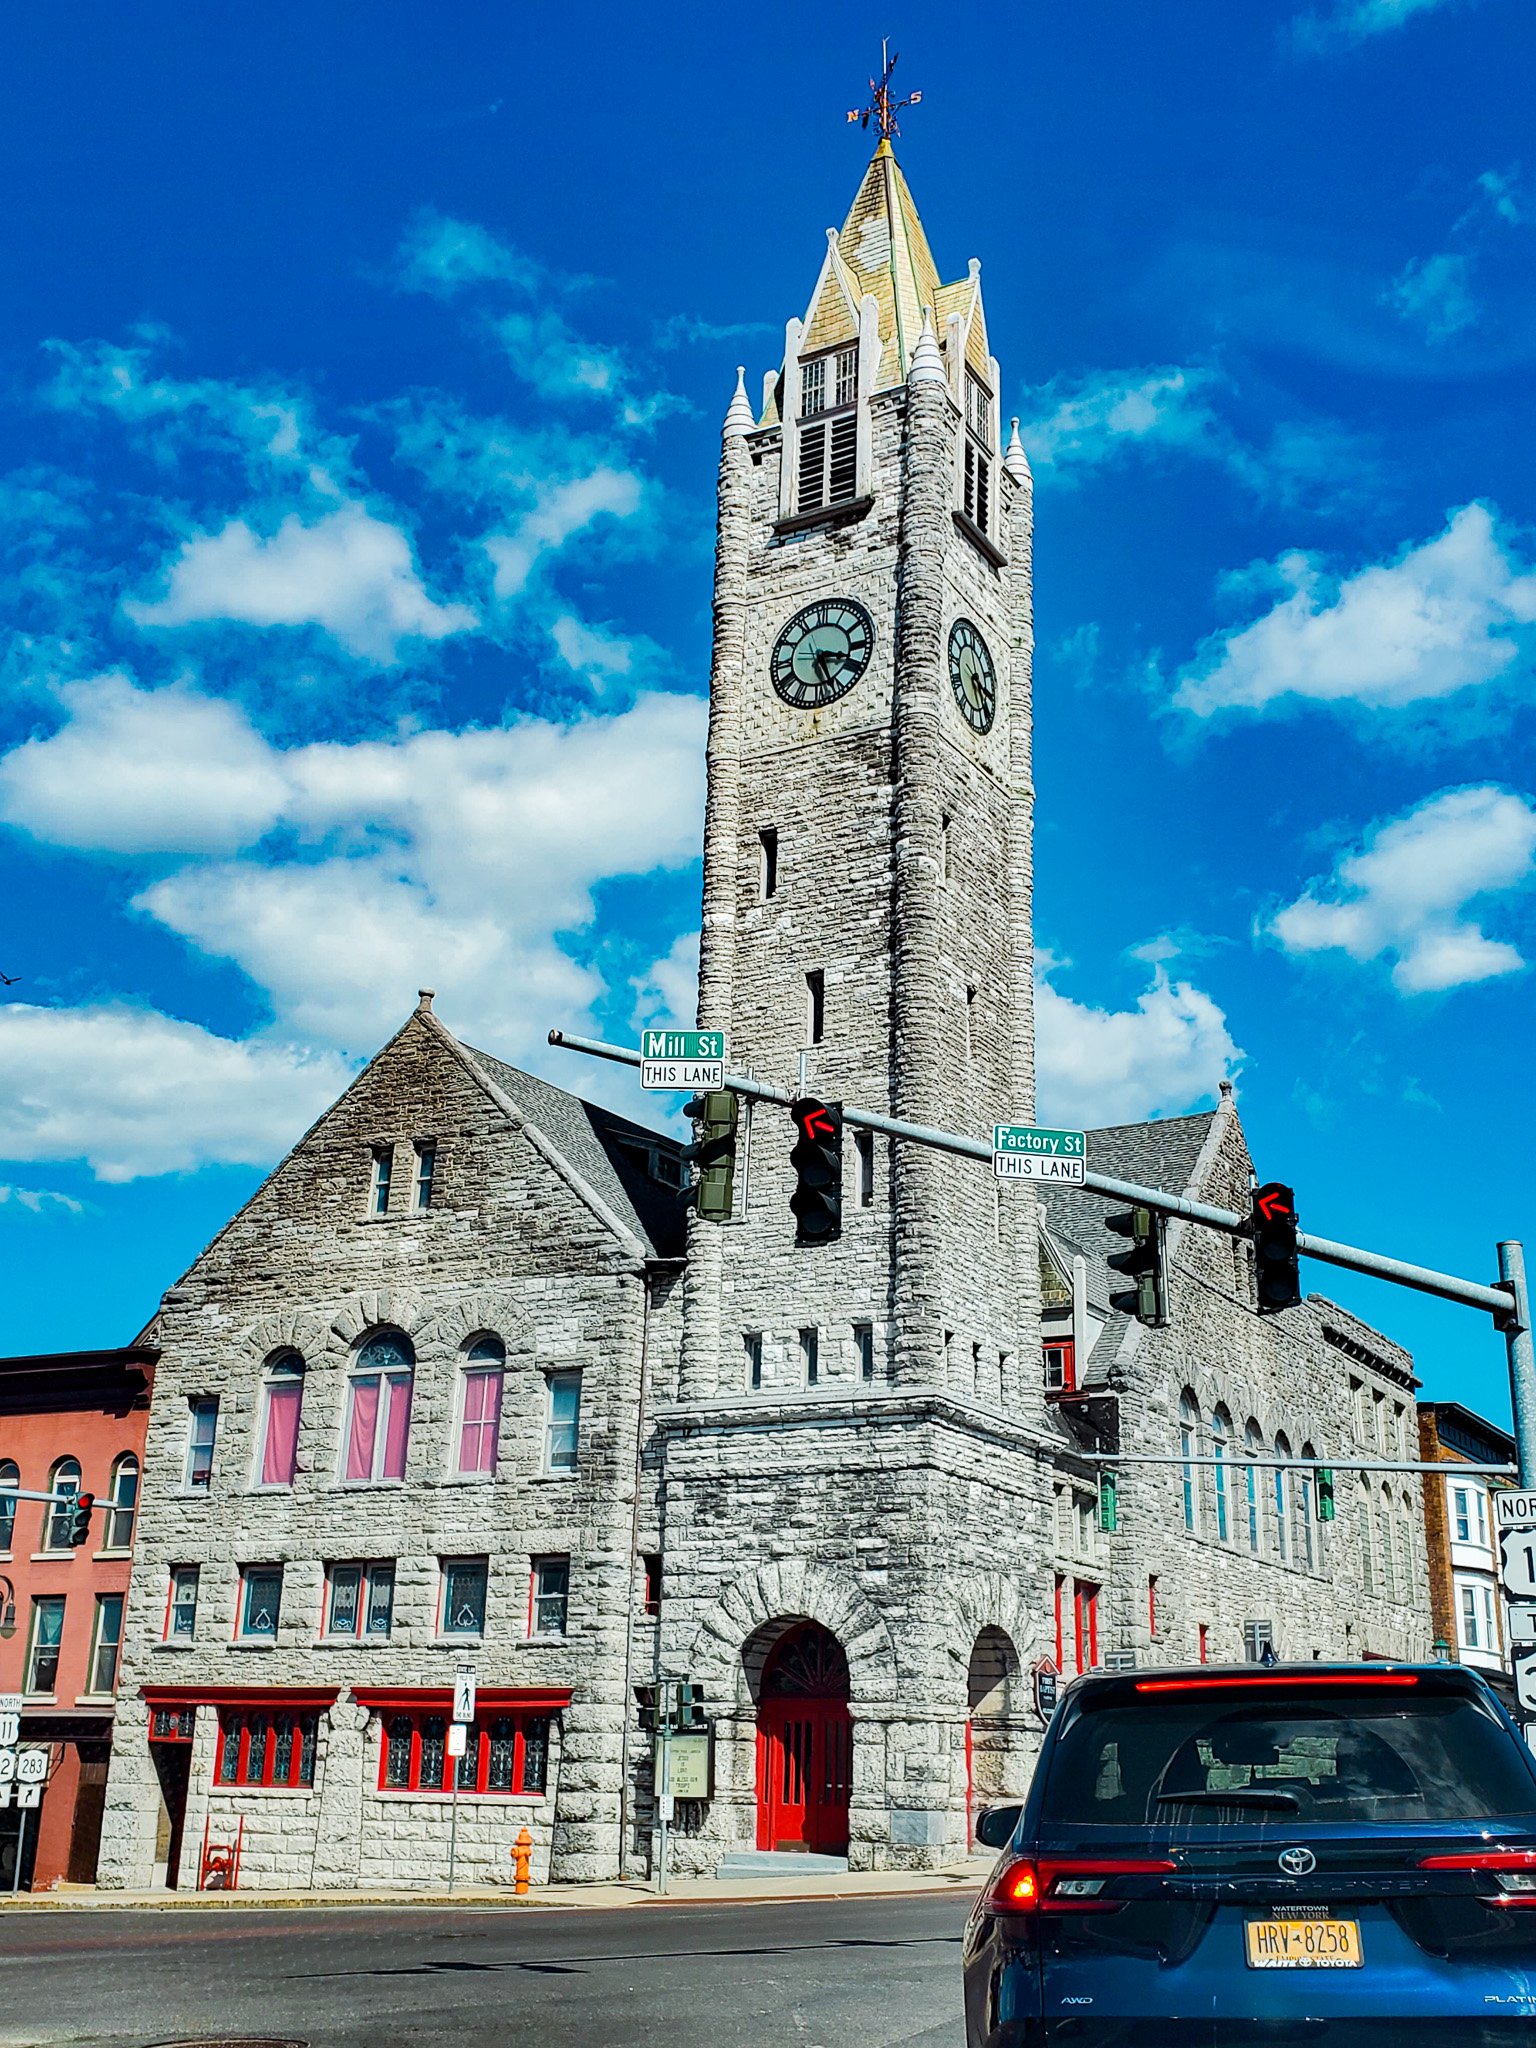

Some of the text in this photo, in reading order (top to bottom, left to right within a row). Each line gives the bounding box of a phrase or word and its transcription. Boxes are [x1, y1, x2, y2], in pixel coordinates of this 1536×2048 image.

[649, 1032, 718, 1057] Mill St
[645, 1066, 720, 1082] THIS LANE
[997, 1126, 1081, 1155] Factory St
[998, 1156, 1081, 1179] THIS LANE
[0, 1698, 20, 1708] NORTH
[2, 1721, 12, 1739] 11
[0, 1758, 10, 1775] 2
[22, 1758, 43, 1774] 283
[1272, 1911, 1330, 1919] NEW YORK
[1257, 1924, 1350, 1953] HRV 8258
[1316, 1959, 1358, 1968] TOYOTA
[1060, 1997, 1094, 2005] AWD
